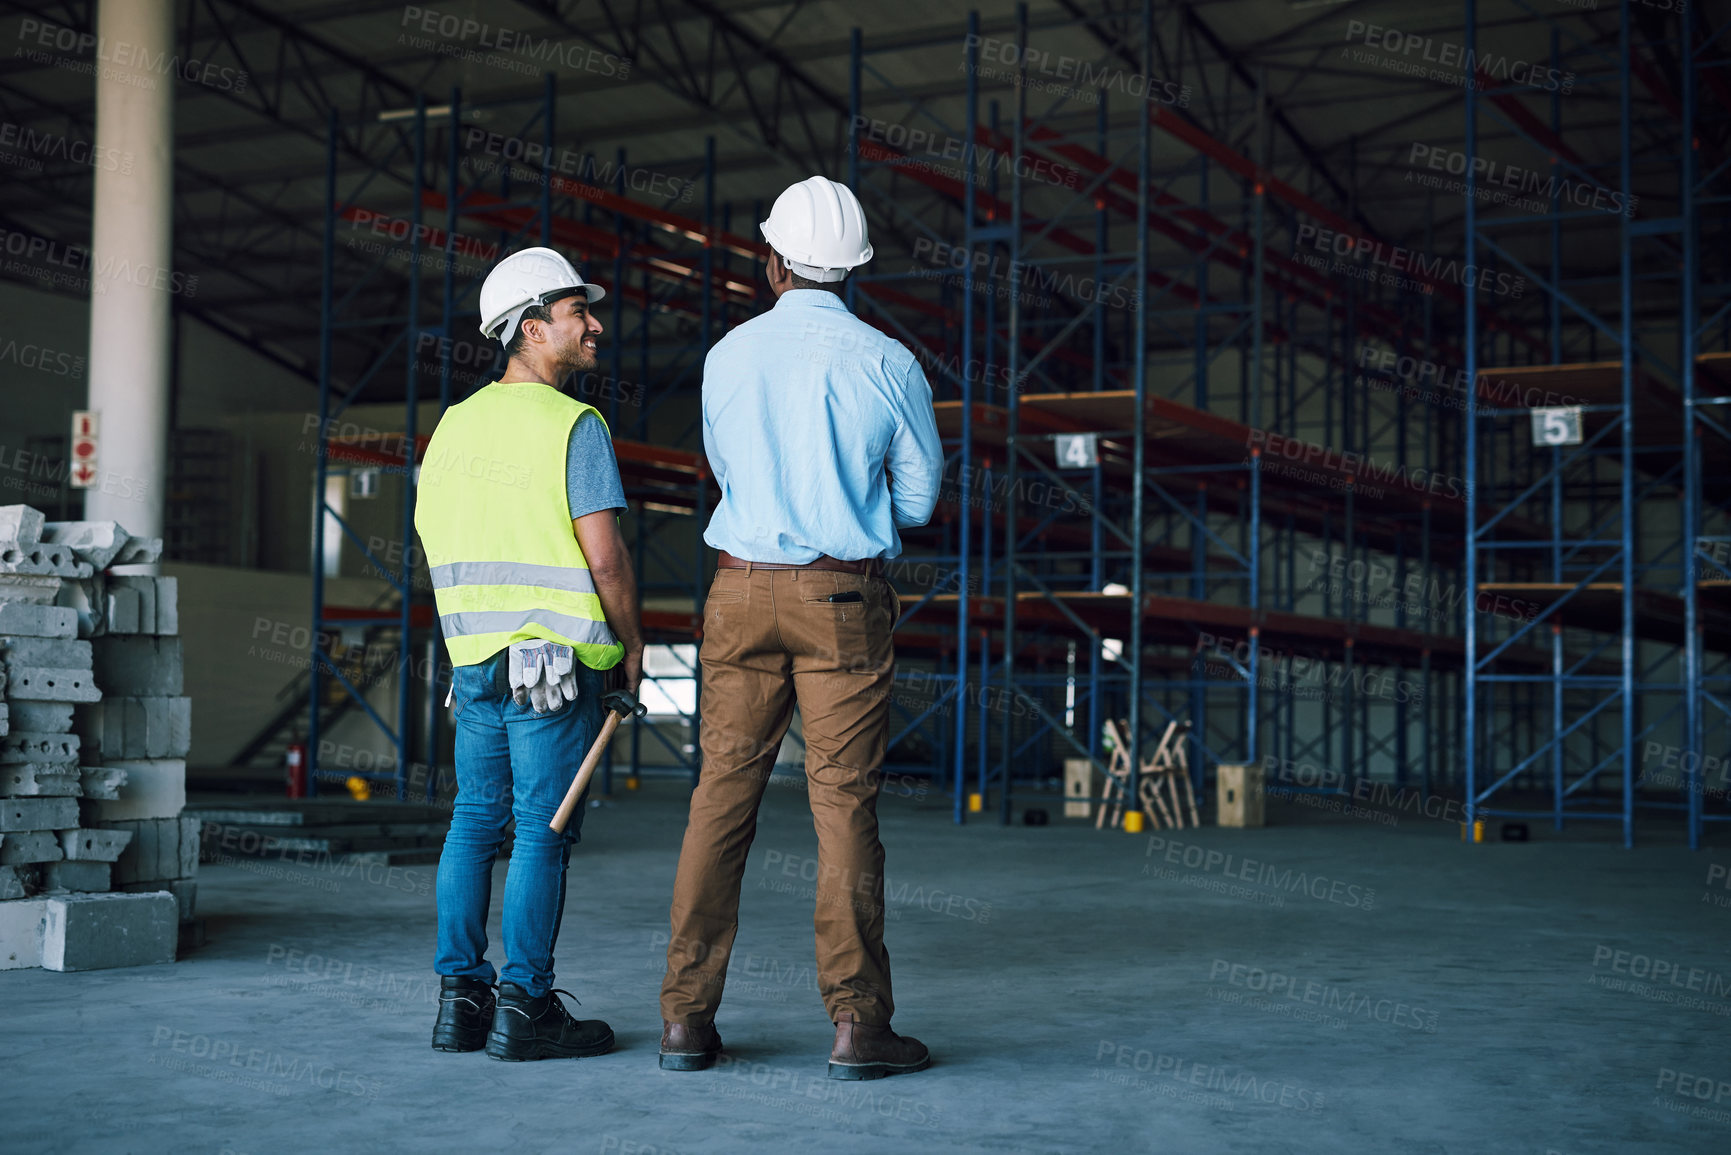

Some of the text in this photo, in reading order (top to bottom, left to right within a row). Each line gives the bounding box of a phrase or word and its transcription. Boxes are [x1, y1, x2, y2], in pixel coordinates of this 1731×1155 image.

[1544, 409, 1568, 444] 5
[1066, 436, 1088, 467] 4
[359, 469, 370, 499] 1
